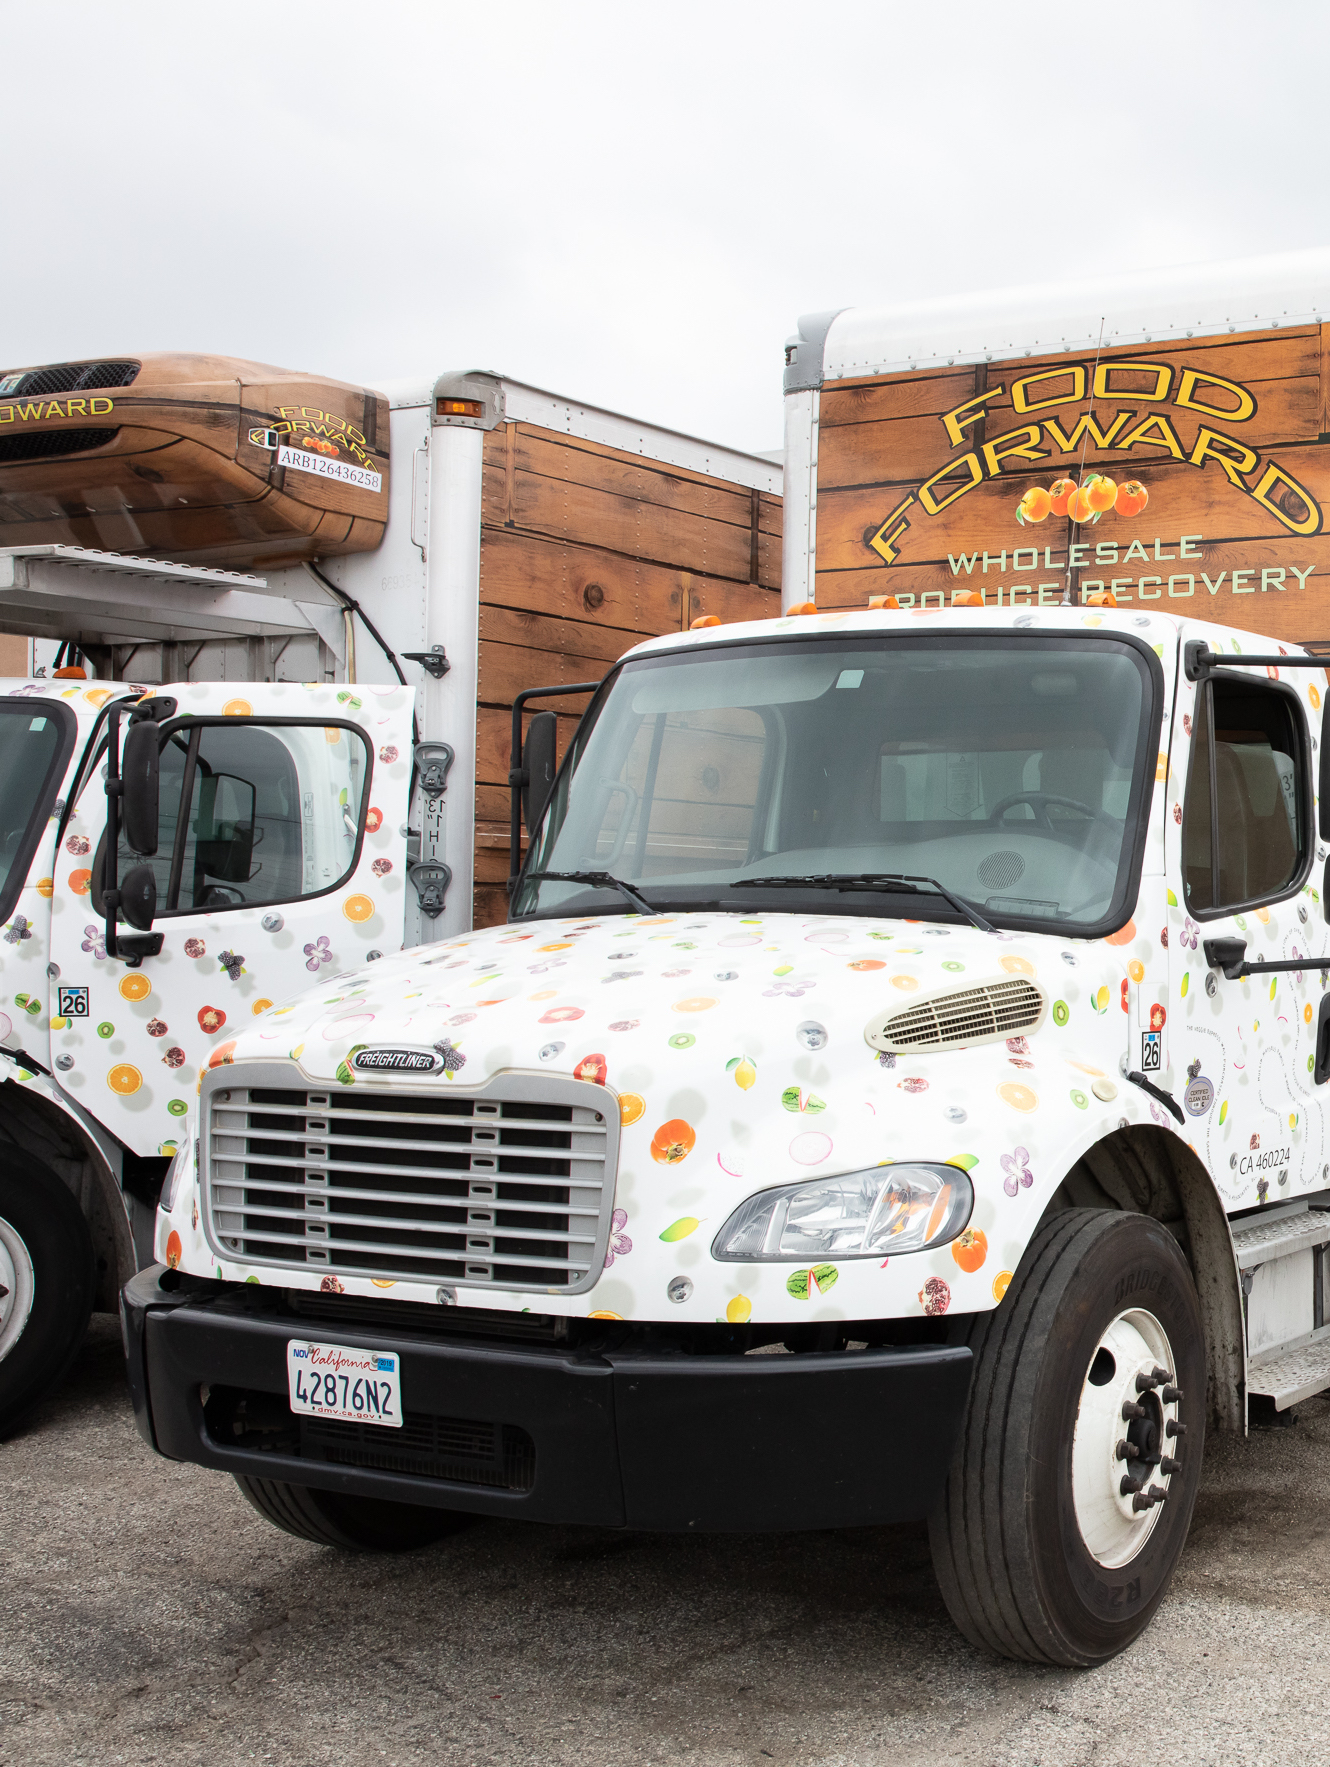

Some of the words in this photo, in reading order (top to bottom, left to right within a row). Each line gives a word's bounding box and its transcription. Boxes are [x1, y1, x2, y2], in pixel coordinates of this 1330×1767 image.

[939, 361, 1258, 448] FOOD
[279, 406, 367, 445] FOOD
[281, 450, 379, 488] ARB126436258
[868, 409, 1324, 566] FORWARD
[947, 534, 1203, 577] WHOLESALE
[1081, 565, 1316, 603] RECOVERY
[63, 995, 86, 1014] 26
[358, 1052, 433, 1068] FREIGHTLINER
[1144, 1041, 1159, 1067] 26
[1240, 1156, 1254, 1175] CA
[1256, 1147, 1291, 1170] 460224
[293, 1349, 309, 1359] NOV
[311, 1348, 379, 1372] California
[296, 1370, 393, 1416] 42876N2
[318, 1407, 375, 1419] dmv.ca.gov
